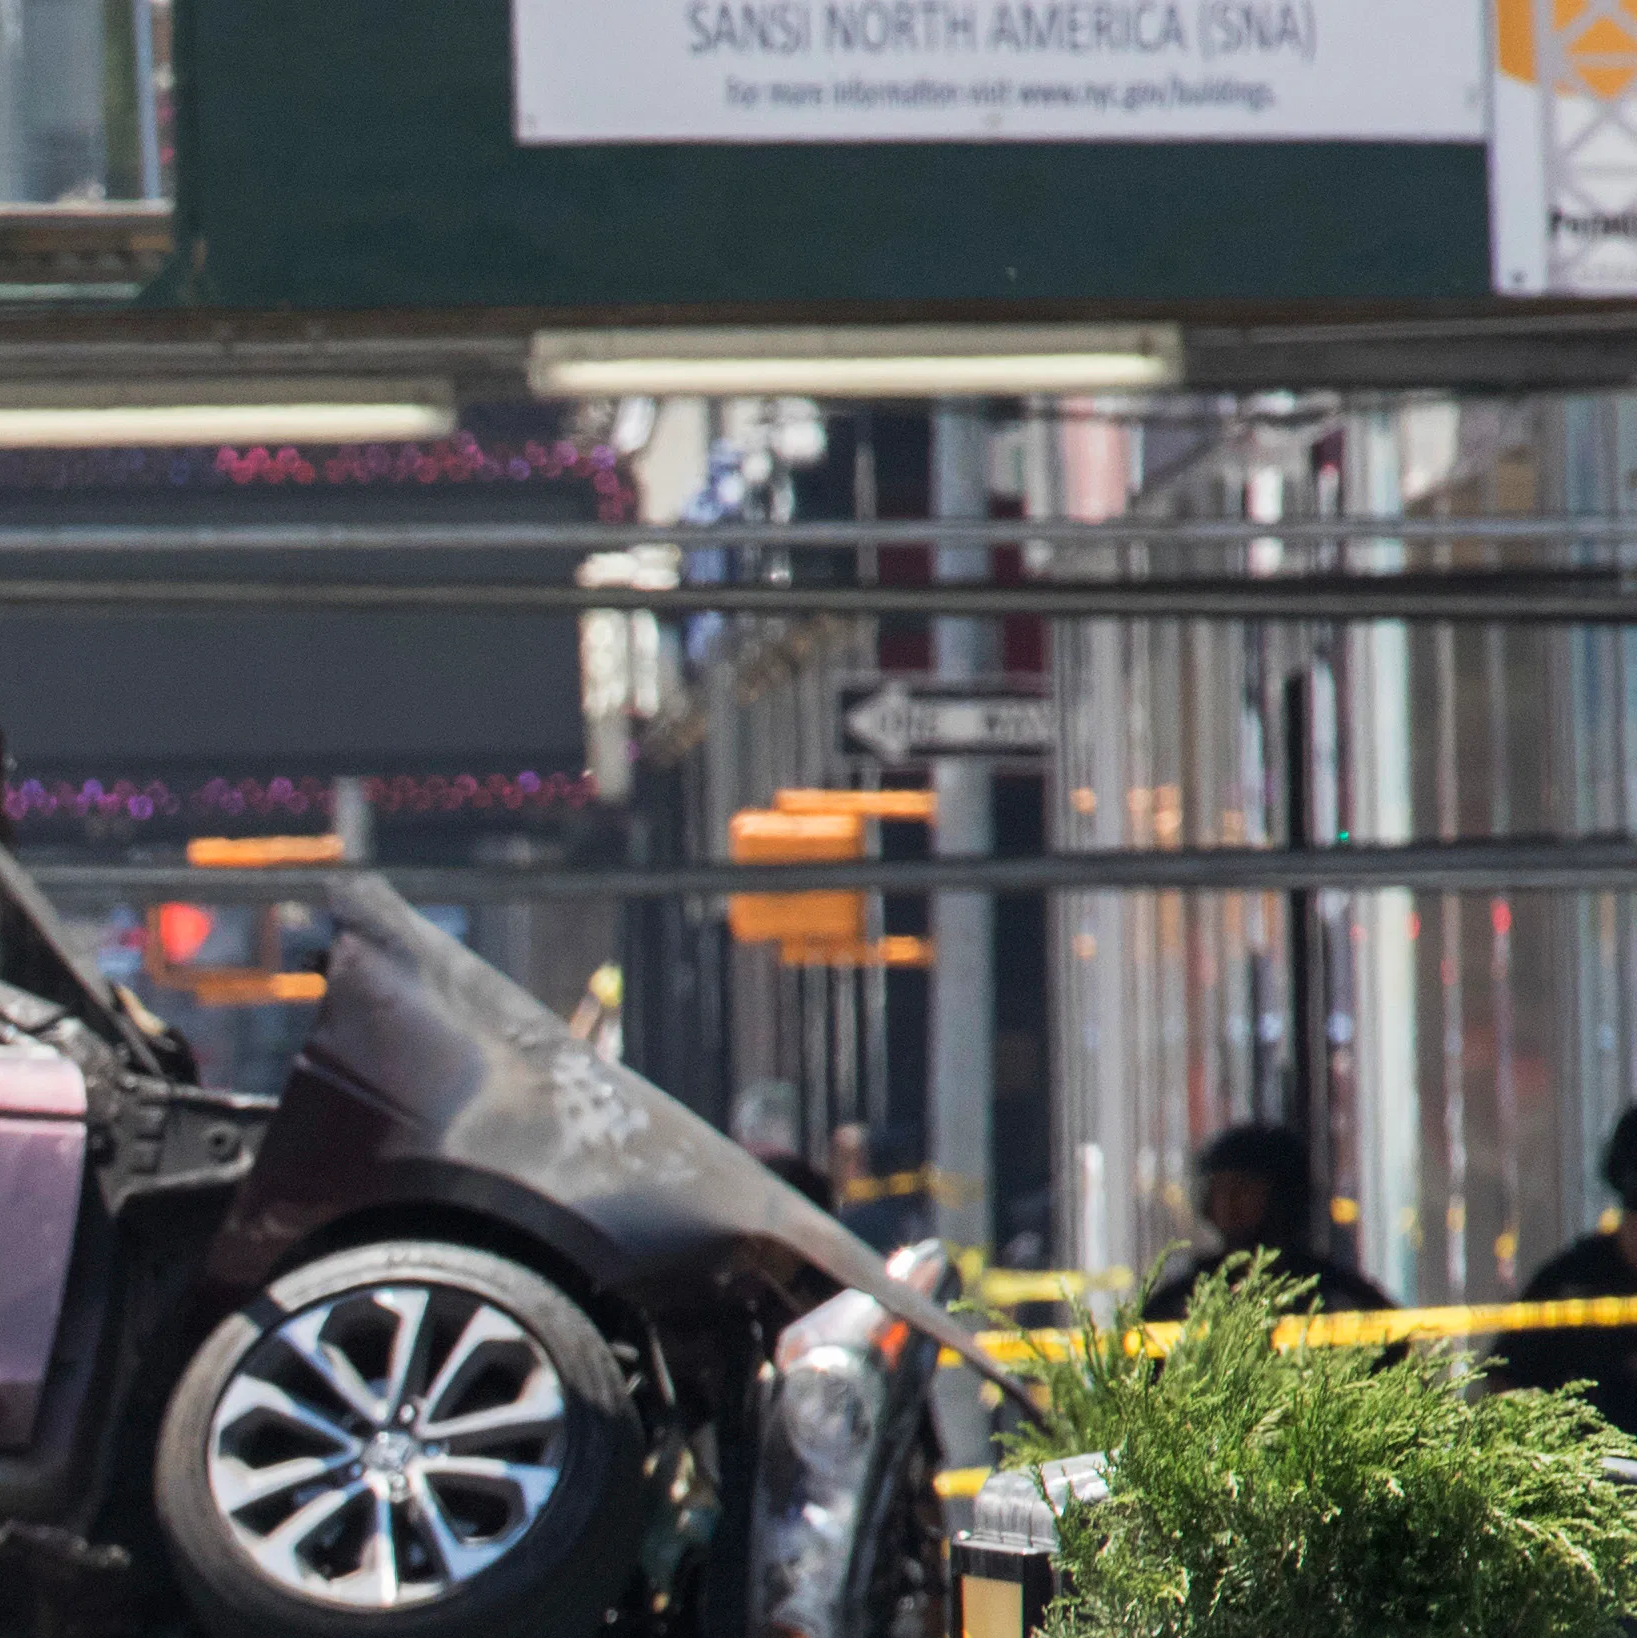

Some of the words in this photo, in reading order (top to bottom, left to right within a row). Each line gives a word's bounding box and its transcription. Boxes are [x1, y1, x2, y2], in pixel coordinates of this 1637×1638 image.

[687, 0, 811, 55] SANSI
[825, 0, 975, 52] NORTH
[986, 0, 1189, 52] AMERICA
[1197, 0, 1317, 61] (SNA)
[833, 75, 957, 105] information
